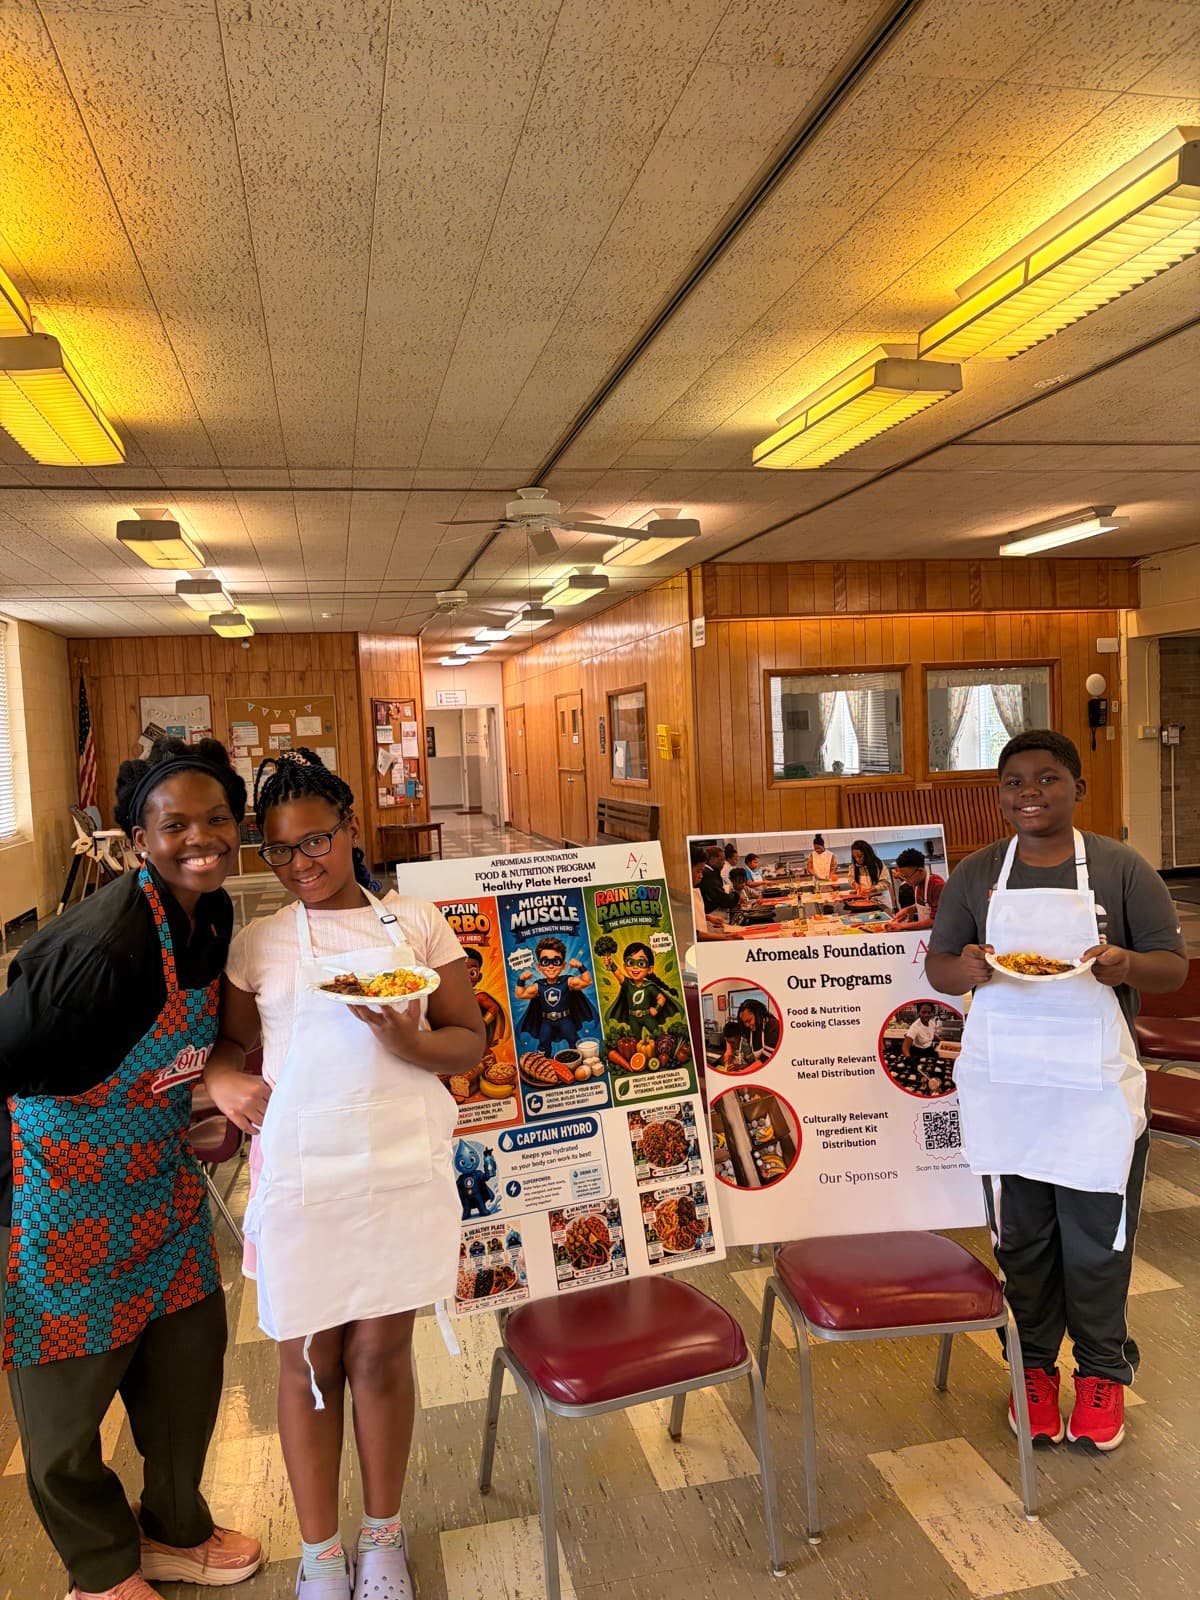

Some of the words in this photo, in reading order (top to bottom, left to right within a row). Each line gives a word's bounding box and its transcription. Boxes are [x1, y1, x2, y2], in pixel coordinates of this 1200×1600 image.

[491, 857, 532, 867] AFROMEALS
[534, 852, 578, 863] FOUNDATION
[475, 872, 500, 880] FOOD
[510, 866, 554, 877] NUTRITION
[557, 862, 596, 872] PROGRAM
[482, 880, 523, 892] Healthy
[526, 878, 552, 888] Plate
[554, 872, 592, 884] Heroes!
[518, 895, 568, 910] MIGHTY
[596, 886, 660, 906] RAINBOW
[442, 904, 478, 915] PTAIN
[597, 900, 660, 921] RANGER
[448, 914, 490, 932] RBO
[510, 906, 580, 930] MUSCLE
[532, 926, 558, 934] STRENGTH
[746, 946, 819, 962] Afromeals
[822, 942, 905, 958] Foundation
[787, 976, 816, 989] Our
[820, 974, 892, 990] Programs
[787, 1007, 808, 1016] Food
[810, 1006, 818, 1014] &
[820, 1004, 861, 1014] Nutrition
[790, 1020, 826, 1029] Cooking
[828, 1018, 860, 1026] Classes
[791, 1056, 835, 1066] Culturally
[837, 1055, 877, 1064] Relevant
[798, 1070, 818, 1080] Meal
[821, 1068, 875, 1078] Distribution
[459, 1104, 491, 1112] ARBOHYDRATES
[802, 1113, 847, 1124] Culturally
[849, 1111, 889, 1120] Relevant
[516, 1128, 558, 1146] CAPTAIN
[560, 1122, 592, 1138] HYDRO
[816, 1126, 863, 1137] Ingredient
[553, 1144, 578, 1155] hydrated
[822, 1139, 876, 1149] Distribution
[819, 1172, 842, 1184] Our
[845, 1170, 898, 1185] Sponsors
